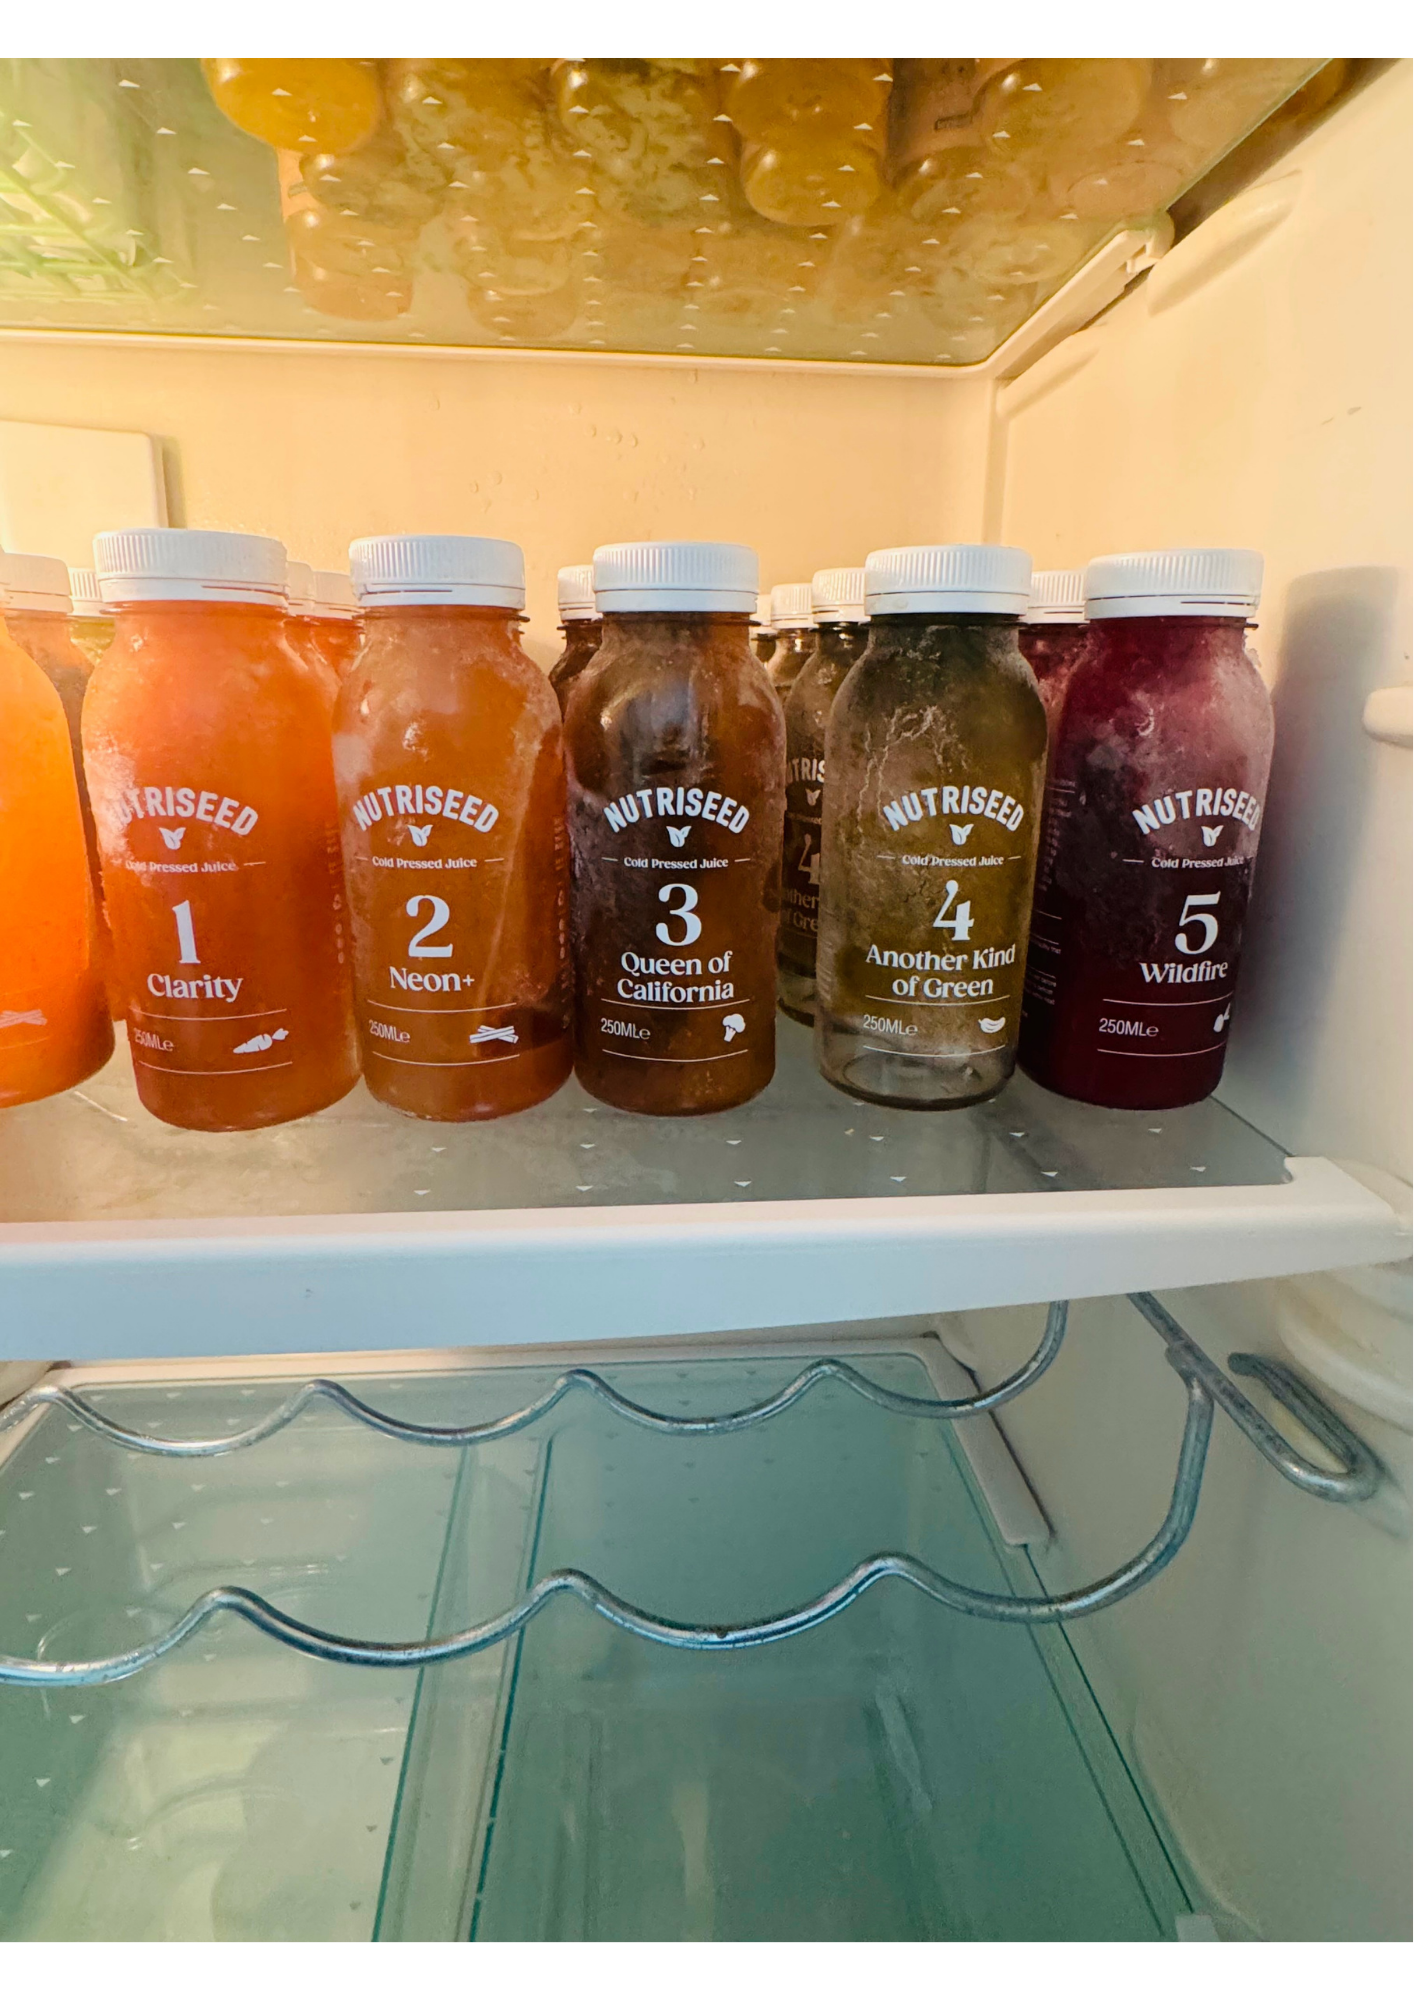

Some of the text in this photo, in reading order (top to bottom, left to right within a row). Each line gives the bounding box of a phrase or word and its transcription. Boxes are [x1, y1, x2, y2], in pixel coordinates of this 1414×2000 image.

[353, 784, 499, 833] NUTRISEED
[603, 786, 750, 835] NUTRISEED
[882, 785, 1024, 832] NUTRISEED
[1131, 787, 1261, 835] NUTRISEED
[149, 862, 198, 873] Pressed
[200, 861, 238, 873] Juice
[372, 855, 478, 869] Cold Pressed Juice
[623, 856, 729, 870] Cold Pressed Juice
[798, 833, 820, 885] 4
[902, 854, 1004, 868] Cold Pressed Juice
[1151, 855, 1245, 869] Cold Pressed Juice
[655, 883, 702, 947] 3
[932, 880, 975, 941] 4
[1174, 891, 1222, 955] 5
[172, 899, 201, 964] 1
[405, 895, 453, 958] 2
[620, 951, 733, 976] Queen of
[865, 944, 968, 972] Another
[972, 943, 1016, 969] Kind
[1139, 960, 1229, 984] Wildfire
[147, 973, 244, 1003] Clarity
[388, 966, 475, 992] Neon+
[616, 978, 734, 1003] California
[891, 976, 994, 998] of Green
